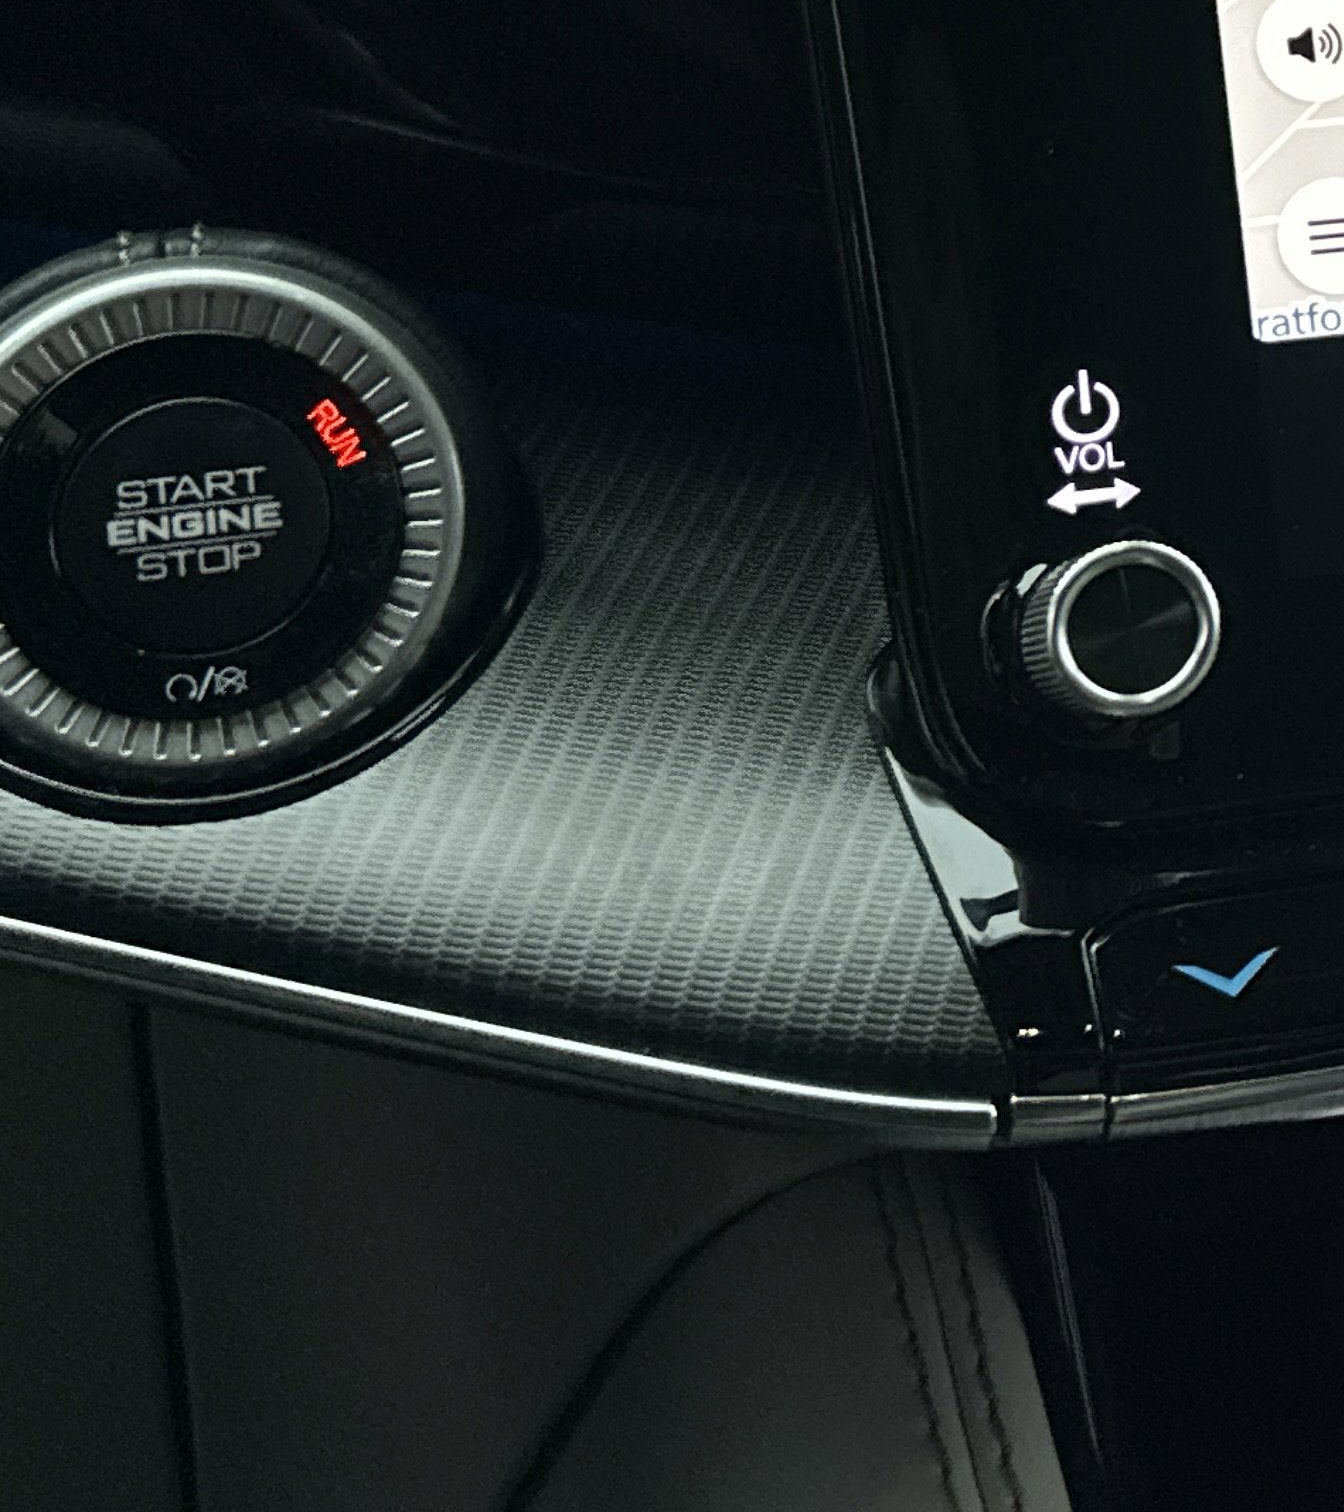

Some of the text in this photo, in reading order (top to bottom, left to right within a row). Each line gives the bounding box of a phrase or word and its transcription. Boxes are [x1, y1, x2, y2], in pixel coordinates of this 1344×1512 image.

[307, 398, 366, 469] RUN
[1054, 441, 1125, 474] VOL
[116, 465, 267, 510] START
[106, 500, 284, 547] ENGINE
[136, 540, 262, 582] STOP
